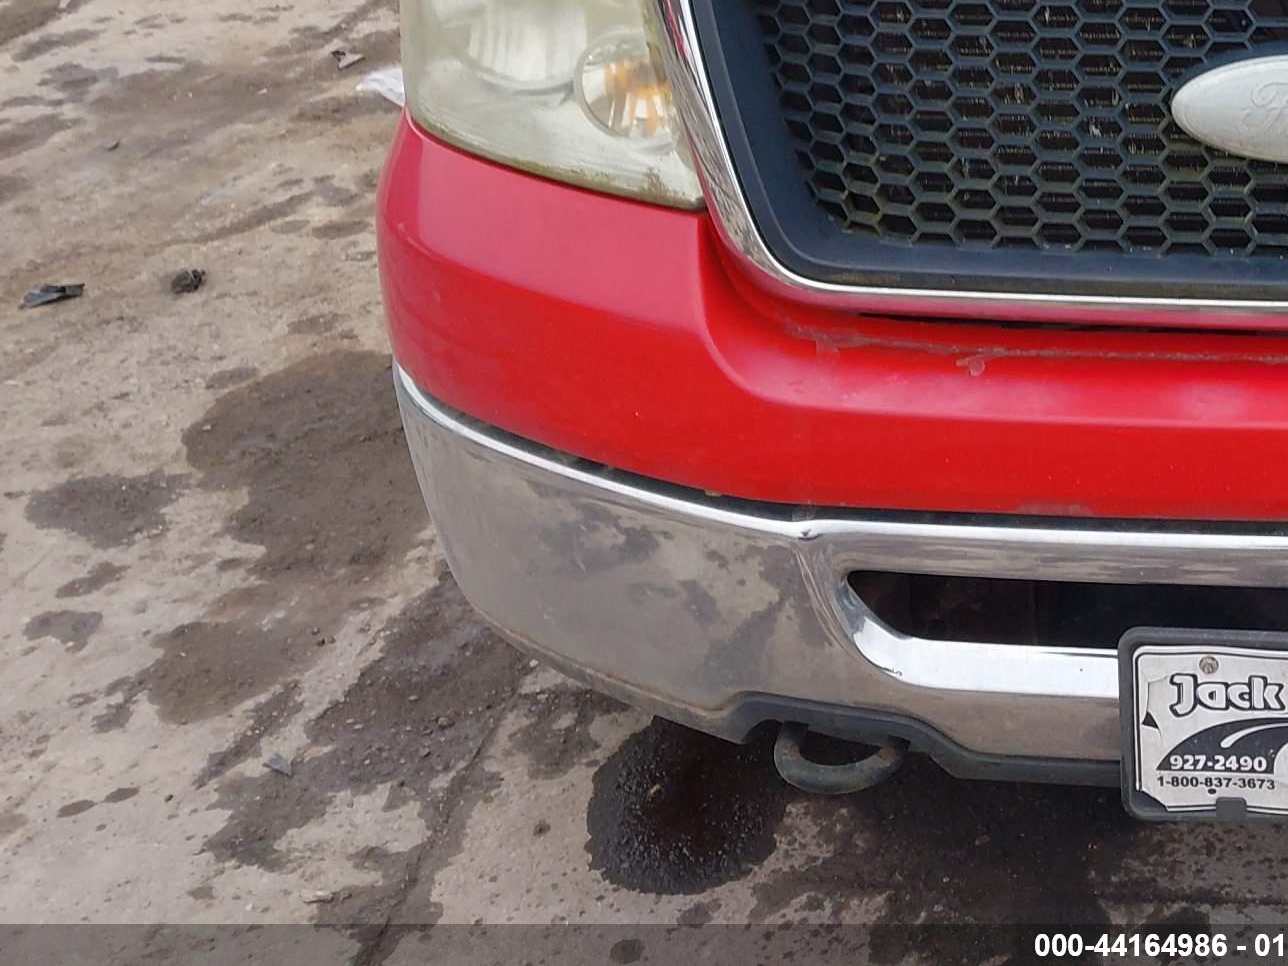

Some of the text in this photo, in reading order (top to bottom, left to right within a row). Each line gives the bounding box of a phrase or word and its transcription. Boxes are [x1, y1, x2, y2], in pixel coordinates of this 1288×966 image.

[1169, 672, 1285, 717] Jack
[1169, 753, 1268, 772] 927-2490
[1157, 775, 1276, 792] 1-800-837-3673
